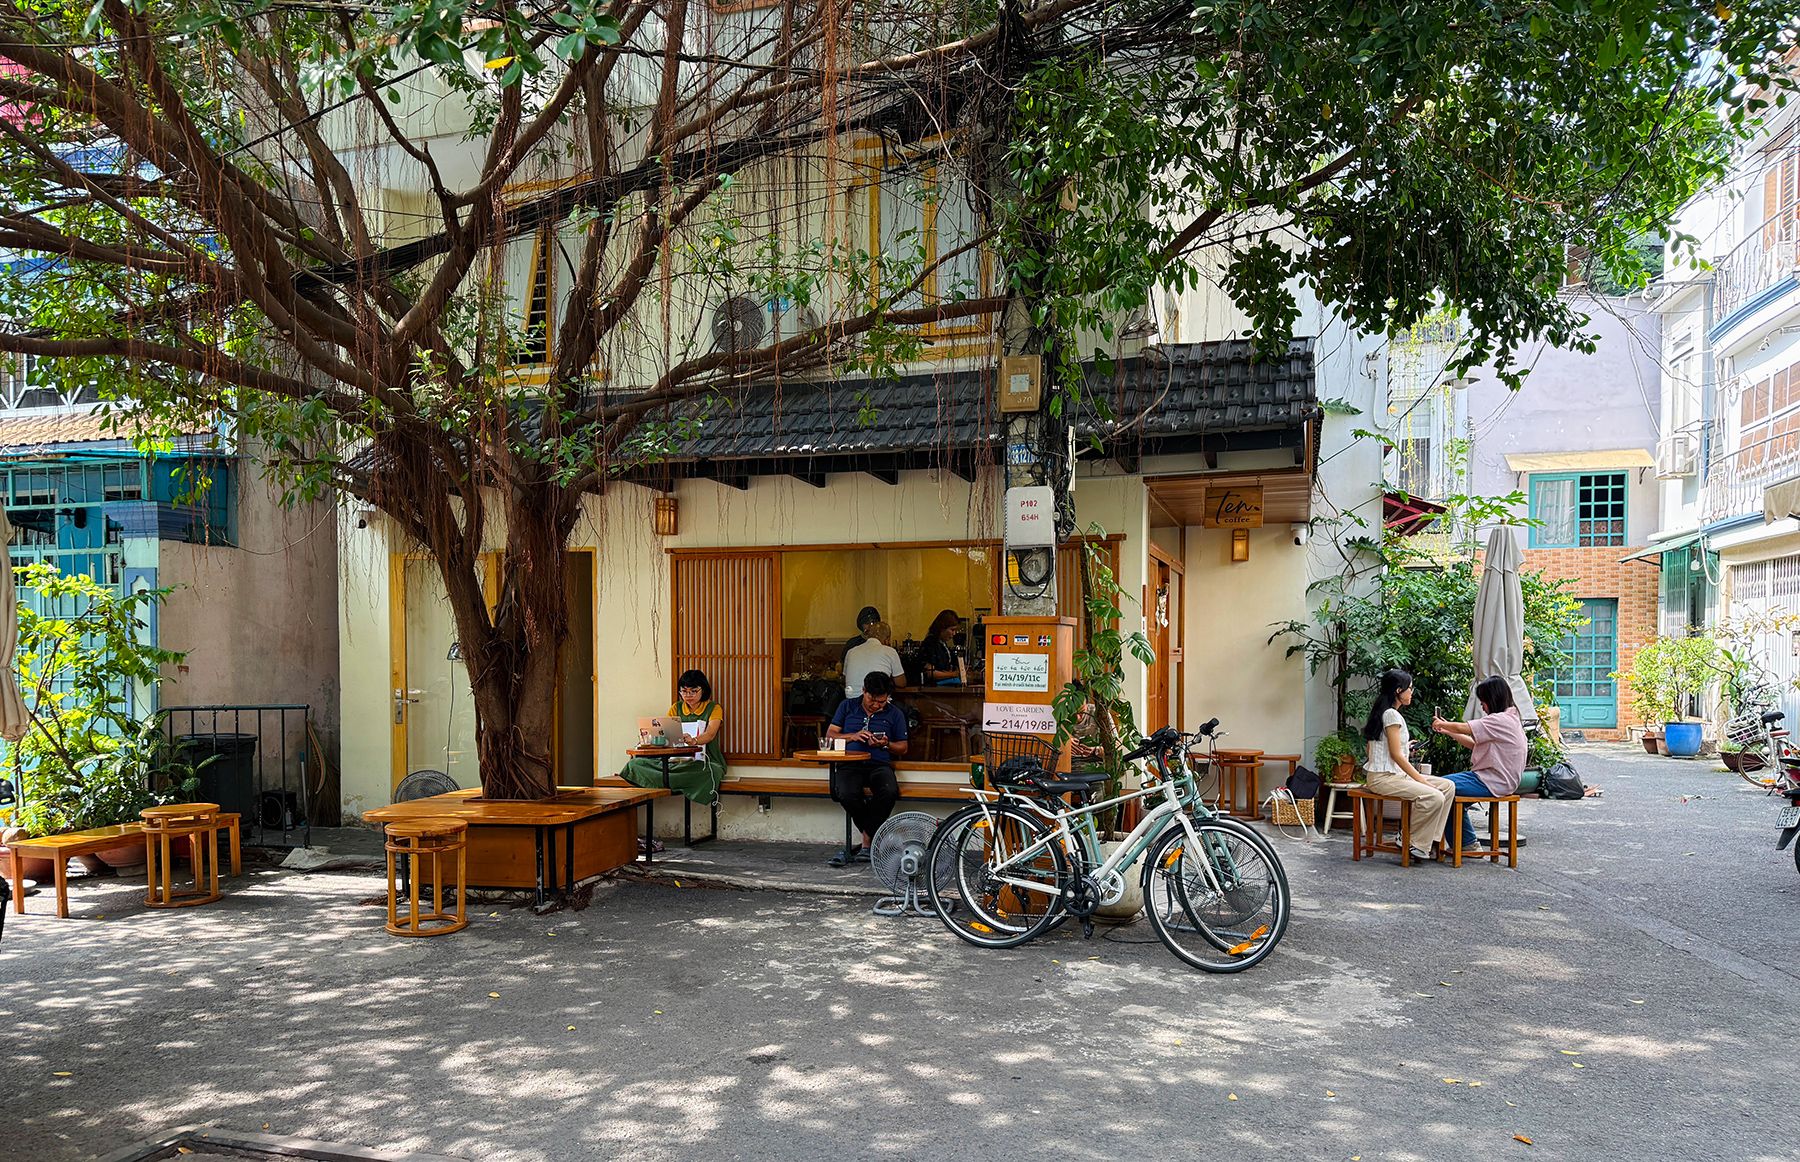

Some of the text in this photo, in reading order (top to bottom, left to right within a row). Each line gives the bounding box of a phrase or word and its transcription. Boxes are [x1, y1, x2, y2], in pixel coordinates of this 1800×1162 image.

[1020, 499, 1038, 508] P102
[1016, 706, 1045, 714] GARDEN
[1001, 719, 1054, 731] 214/19/8F
